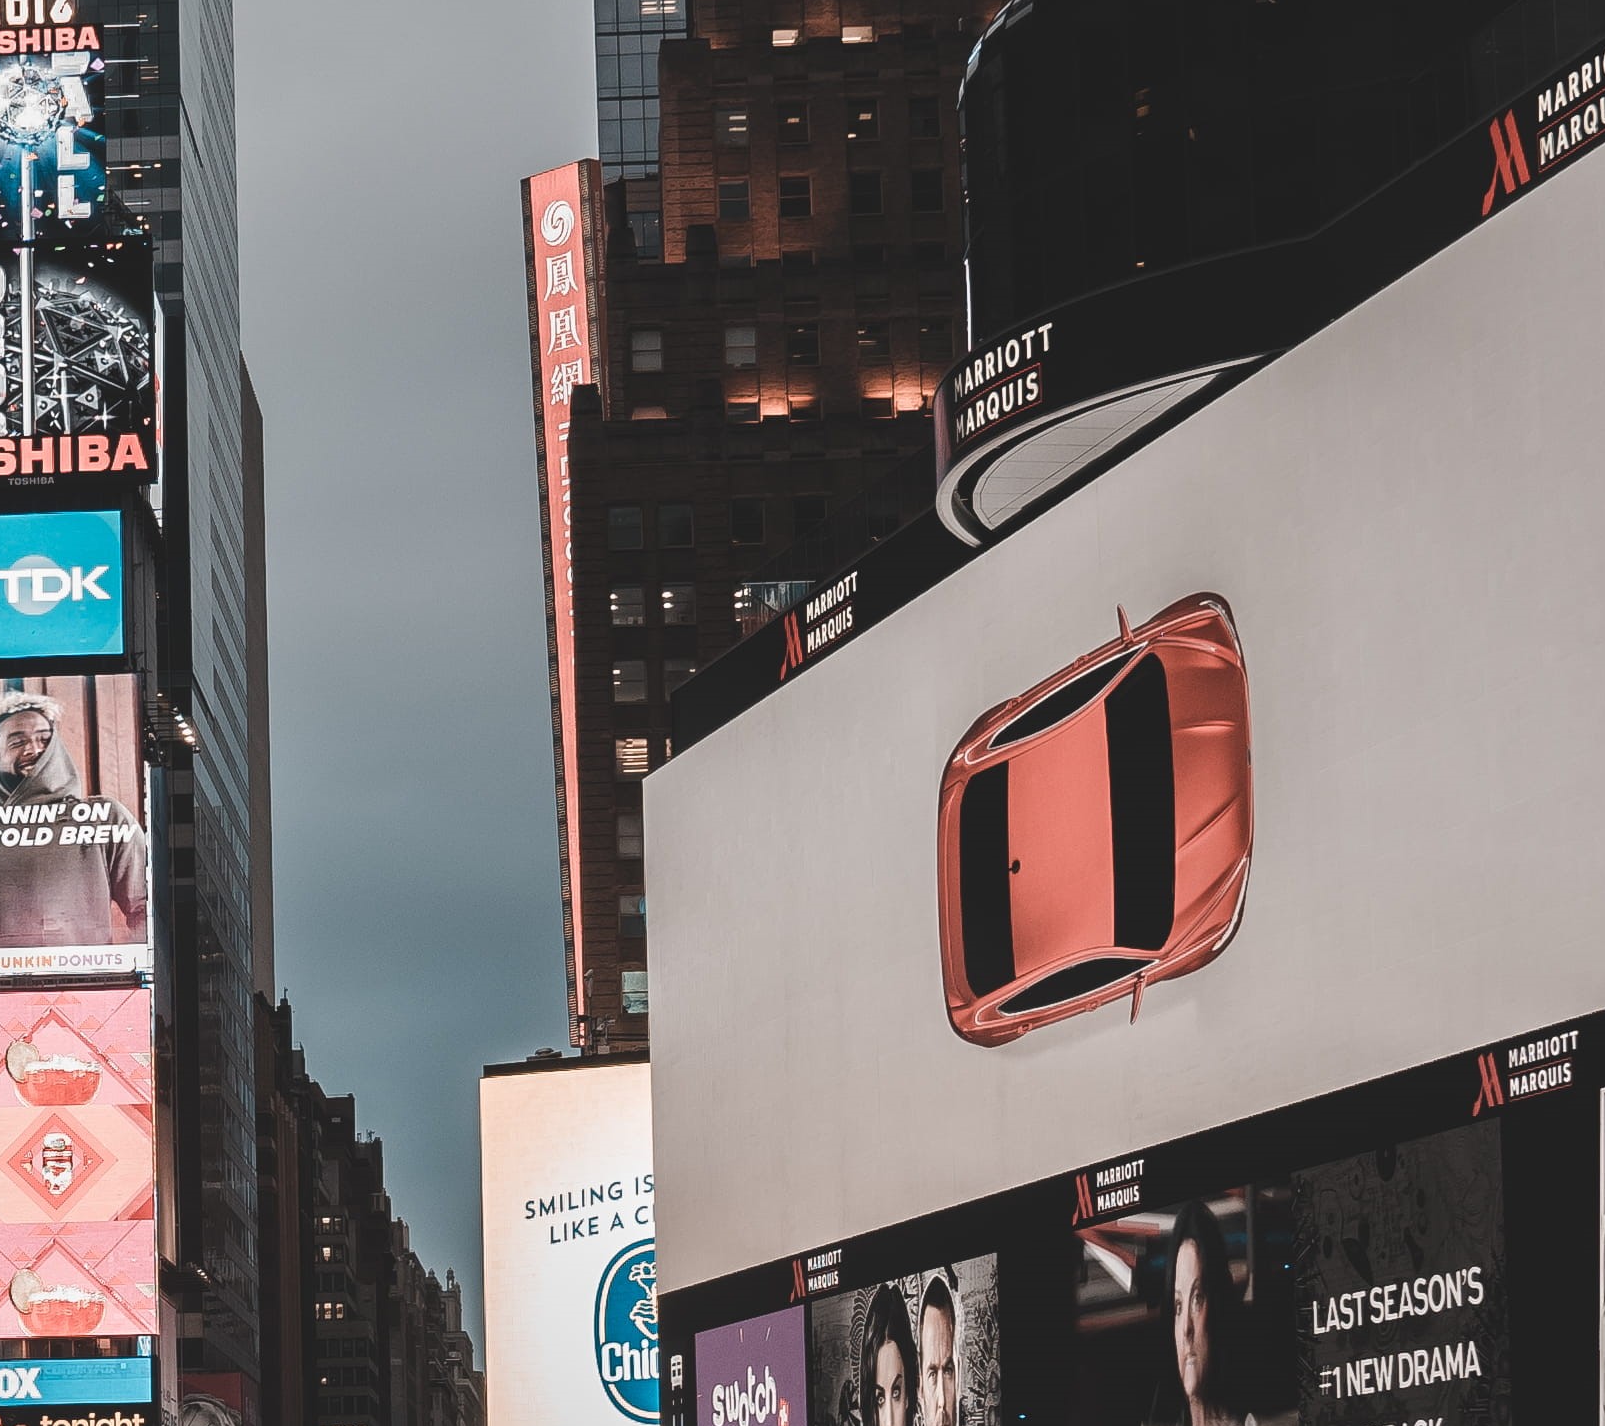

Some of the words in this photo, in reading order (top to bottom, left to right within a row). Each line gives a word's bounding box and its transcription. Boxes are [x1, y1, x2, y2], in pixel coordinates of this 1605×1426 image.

[952, 324, 1054, 402] MARRIOTT
[953, 372, 1042, 443] MARQUIS
[805, 571, 859, 623] MARRIOTT
[805, 603, 855, 655] MARQUIS
[71, 802, 113, 822] ON
[58, 824, 137, 846] BREW
[58, 953, 123, 968] DONUTS
[1507, 1029, 1580, 1068] MARRIOTT
[1508, 1061, 1572, 1099] MARQUIS
[1096, 1160, 1145, 1188] MARRIOTT
[525, 1180, 624, 1221] SMILING
[1096, 1184, 1140, 1212] MARQUIS
[549, 1216, 600, 1245] LIKE
[609, 1214, 625, 1235] A
[807, 1249, 842, 1272] MARRIOTT
[807, 1270, 840, 1293] MARQUIS
[1312, 1292, 1364, 1335] LAST
[1369, 1267, 1485, 1323] SEASON'S
[1346, 1353, 1394, 1397] NEW
[1399, 1340, 1482, 1387] DRAMA
